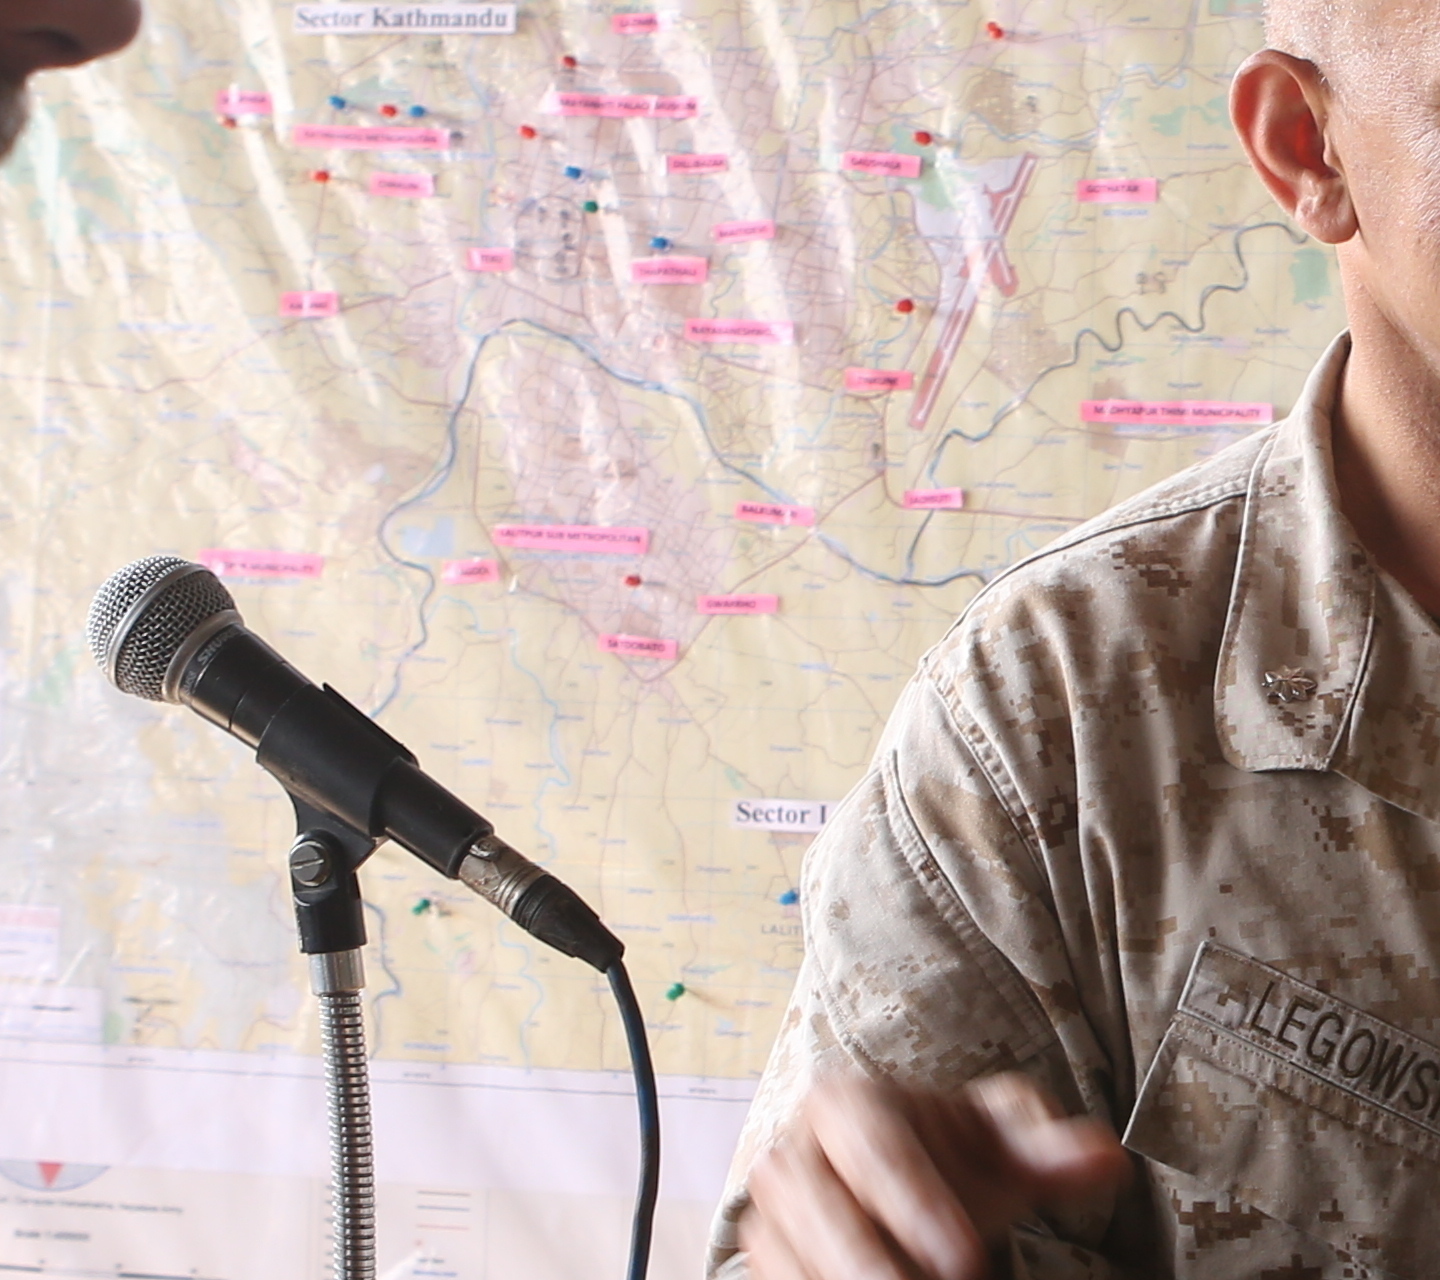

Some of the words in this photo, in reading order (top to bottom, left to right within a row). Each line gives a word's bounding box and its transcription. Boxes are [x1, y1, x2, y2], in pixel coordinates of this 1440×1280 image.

[295, 9, 366, 29] Sector
[372, 8, 509, 29] Kathmandu
[736, 801, 812, 822] Sector
